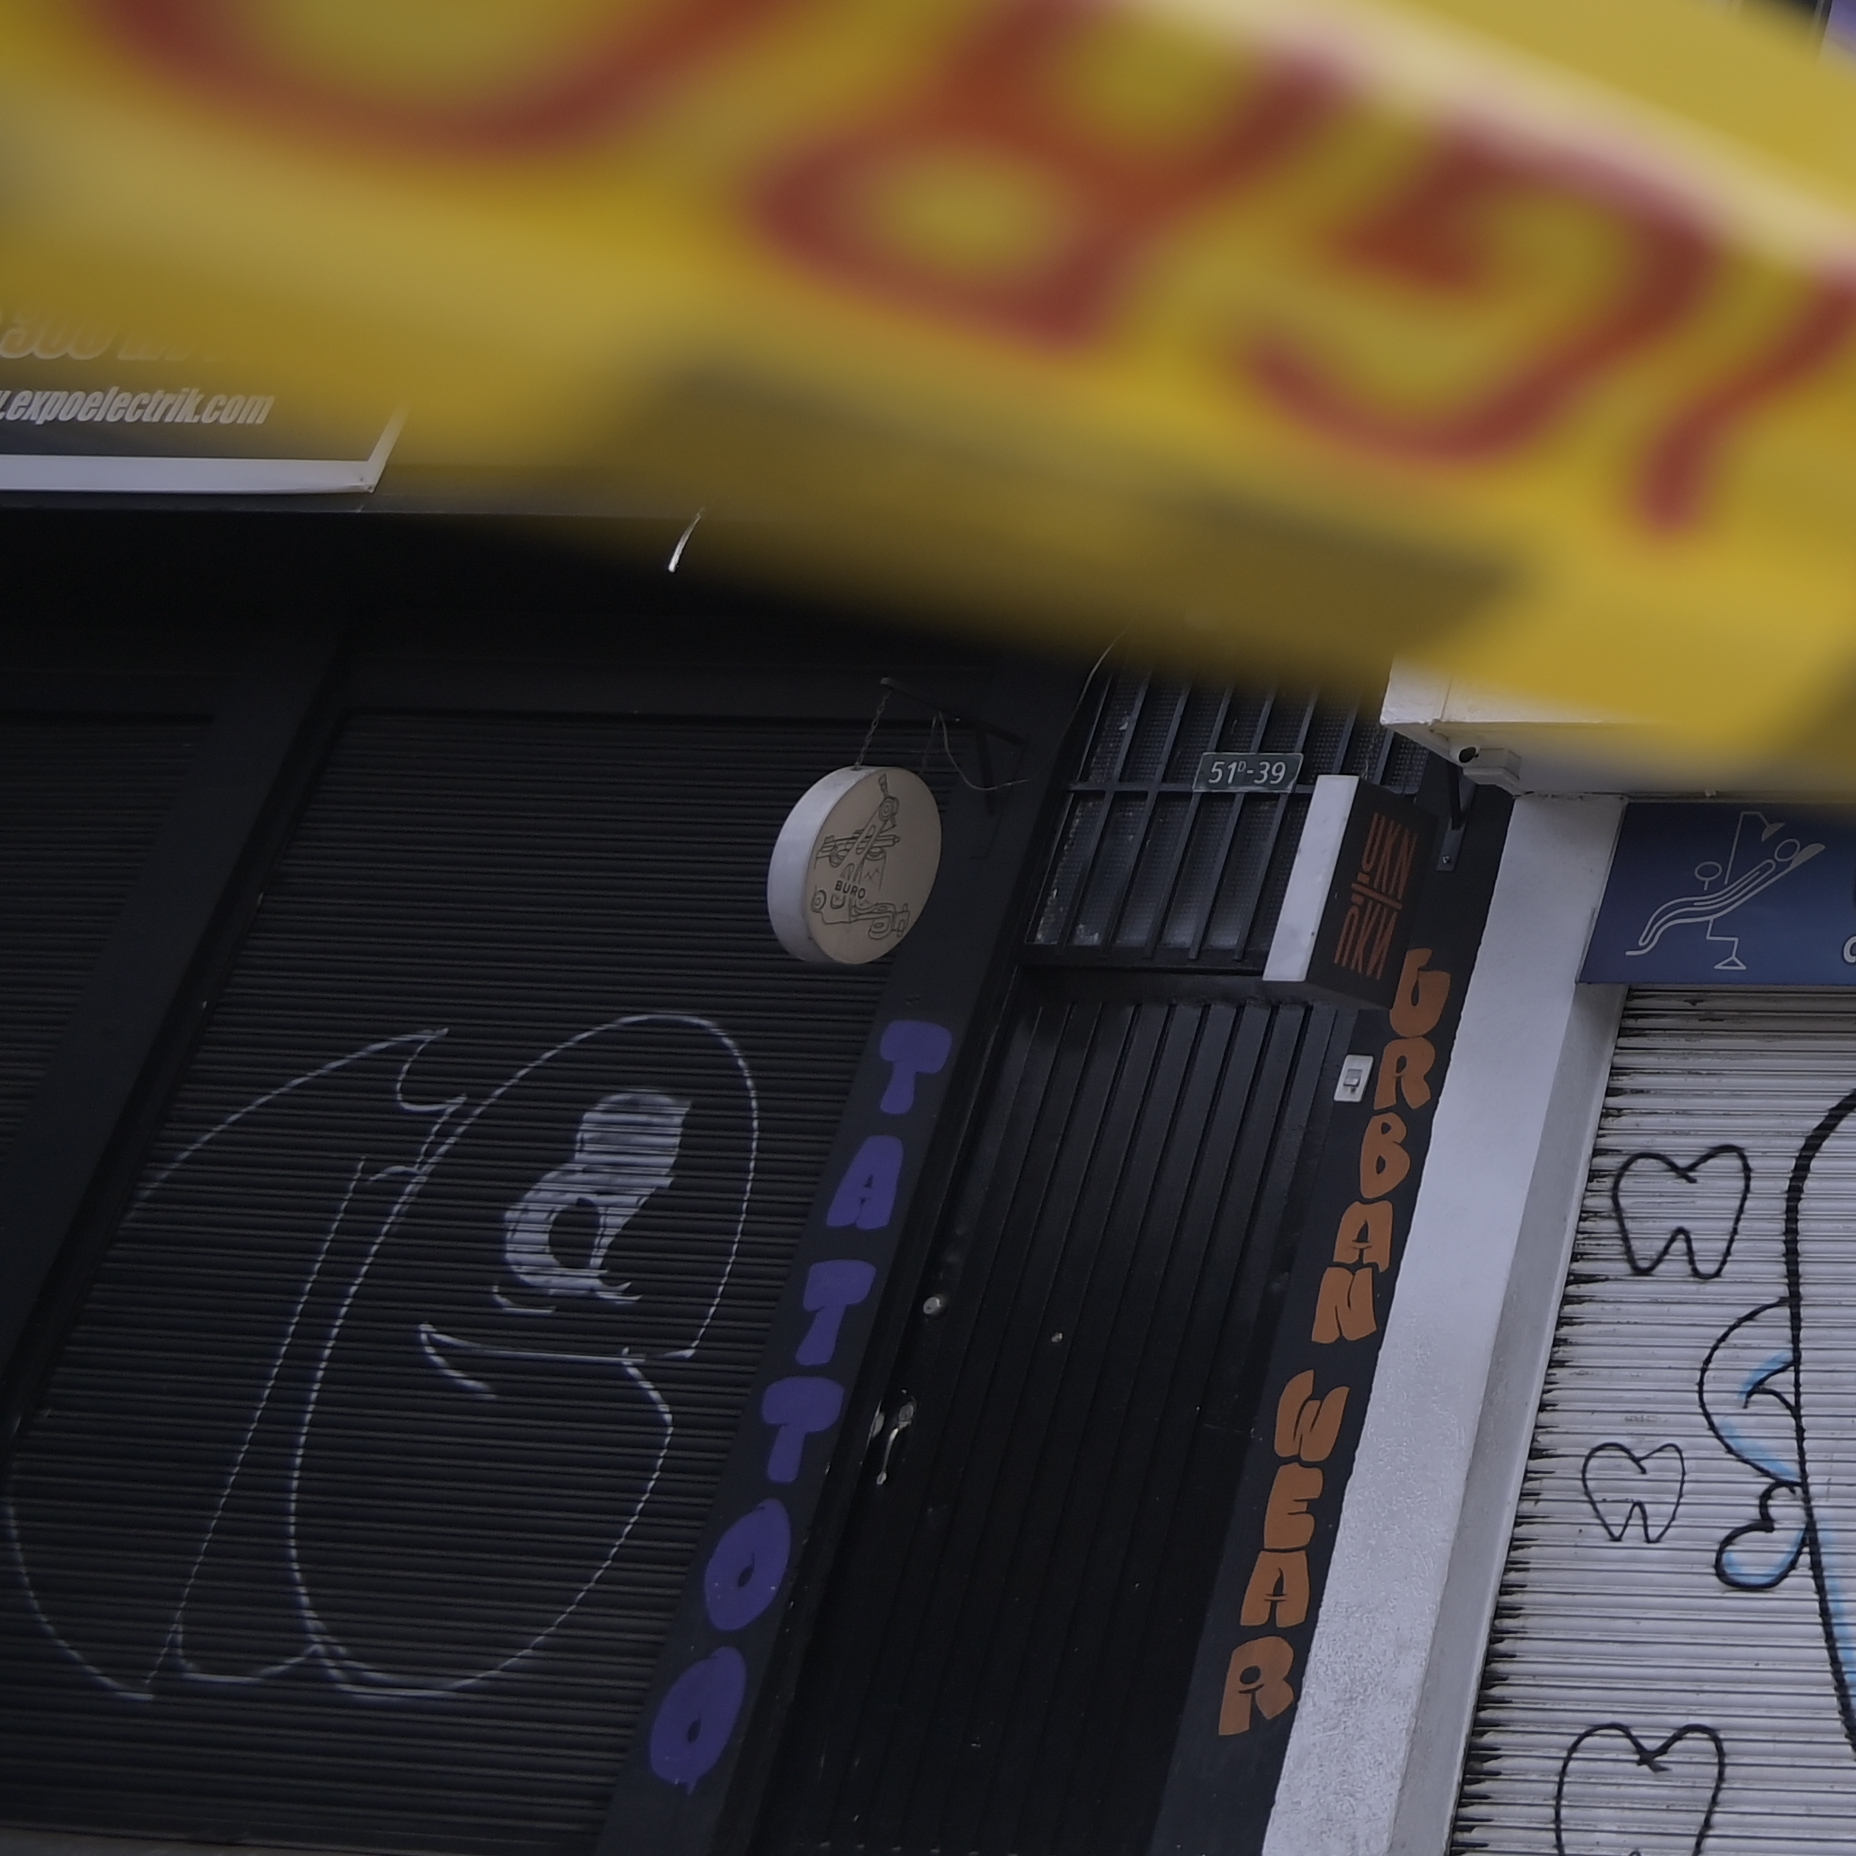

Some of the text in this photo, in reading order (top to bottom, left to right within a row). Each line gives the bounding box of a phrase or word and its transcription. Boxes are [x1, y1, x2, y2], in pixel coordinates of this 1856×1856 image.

[834, 879, 866, 899] BURO
[1309, 947, 1451, 1344] URBAN
[650, 1019, 952, 1795] TATTOO
[1218, 1367, 1351, 1737] WEAR
